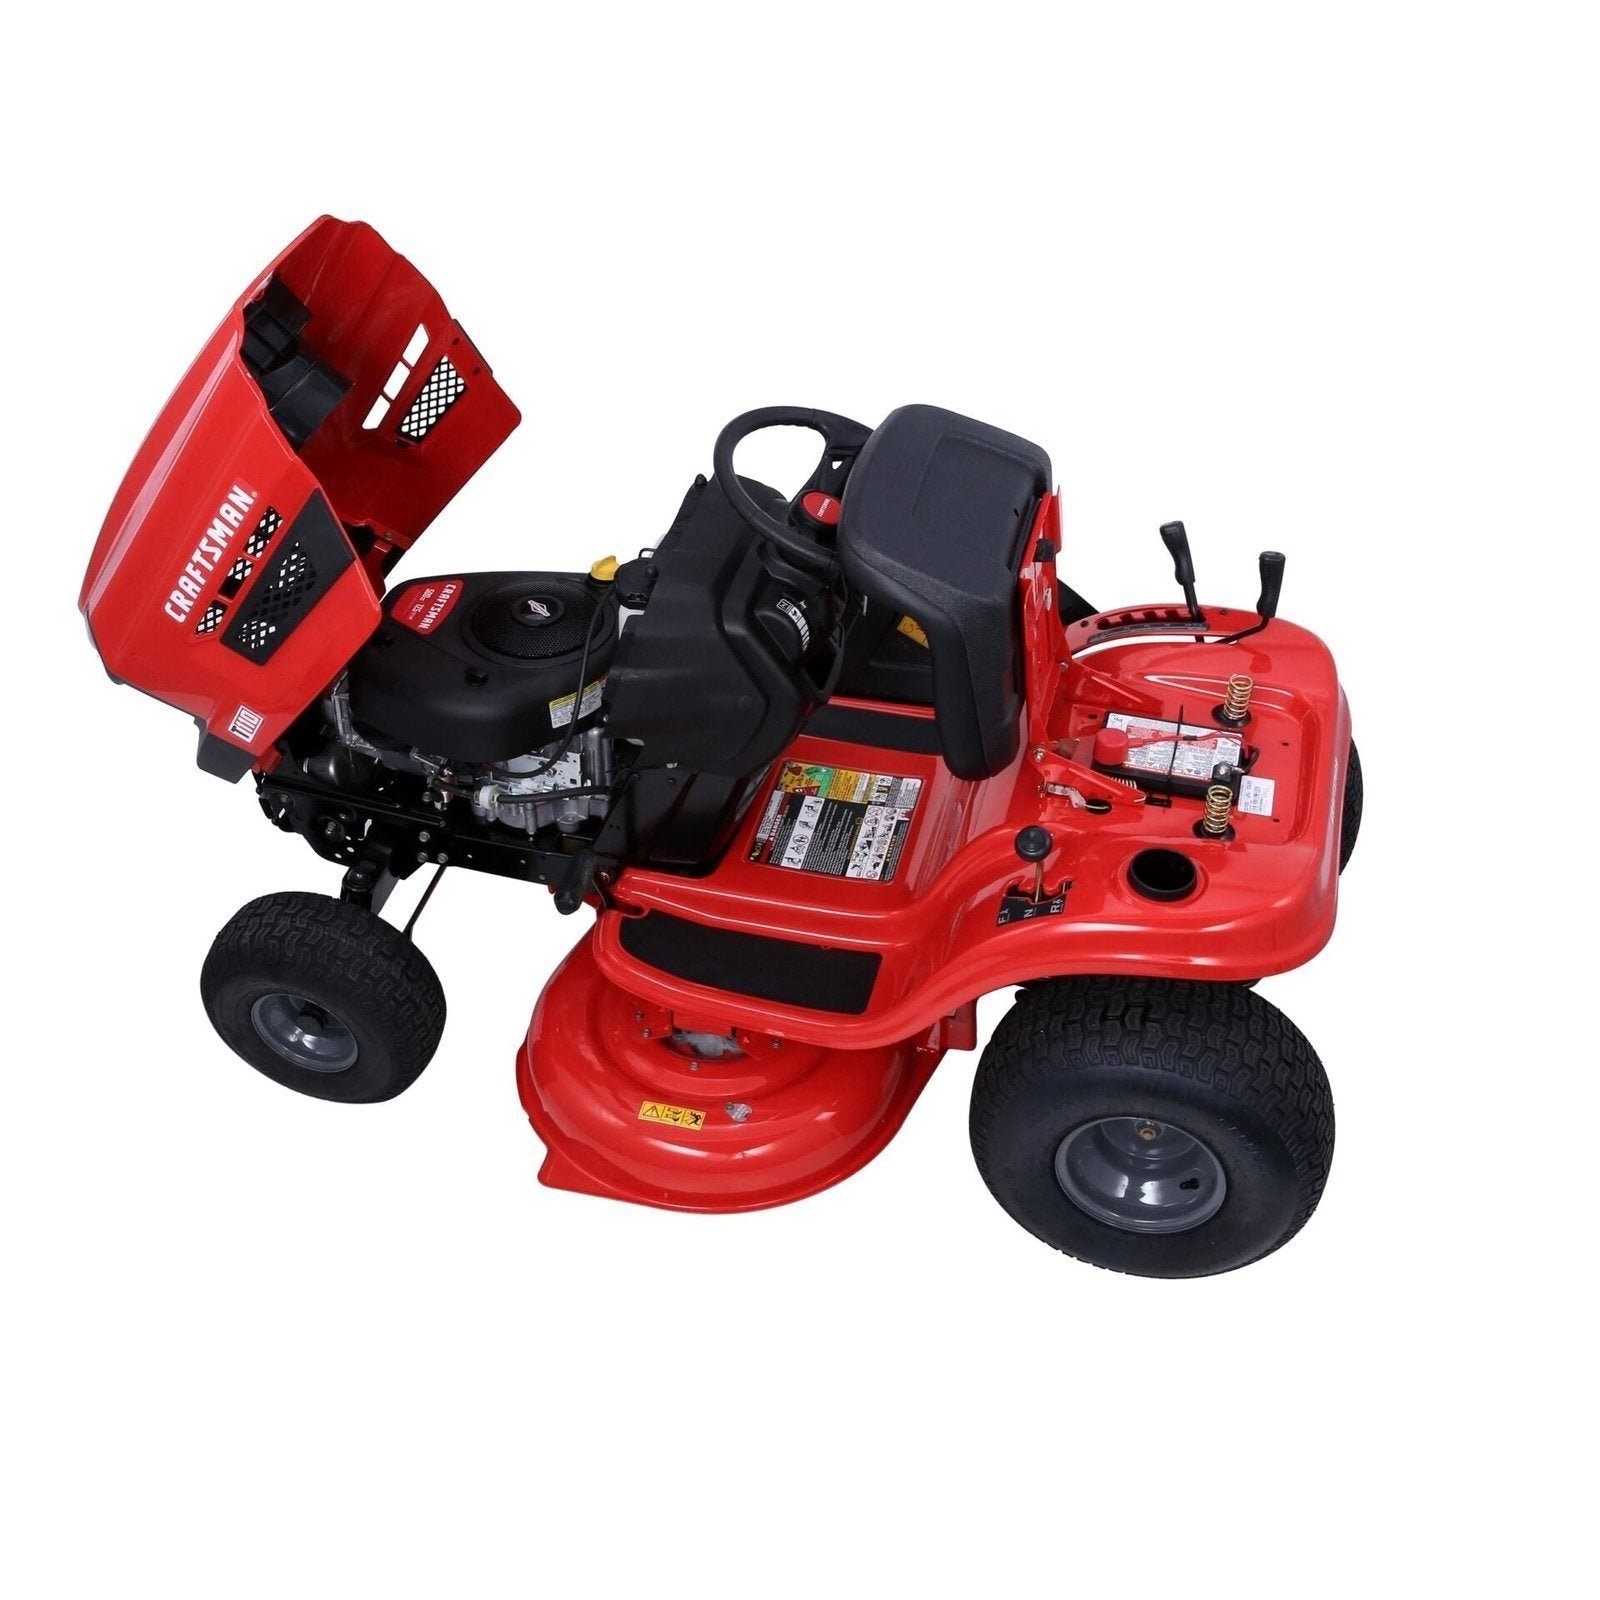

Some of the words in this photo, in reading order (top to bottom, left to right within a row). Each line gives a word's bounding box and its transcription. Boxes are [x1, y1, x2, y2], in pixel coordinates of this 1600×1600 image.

[164, 484, 255, 623] CRAFTSMAN
[419, 584, 456, 629] CRAFTSMAN
[231, 709, 260, 739] T110
[1024, 909, 1033, 918] N
[1050, 905, 1060, 913] R
[998, 916, 1007, 924] F
